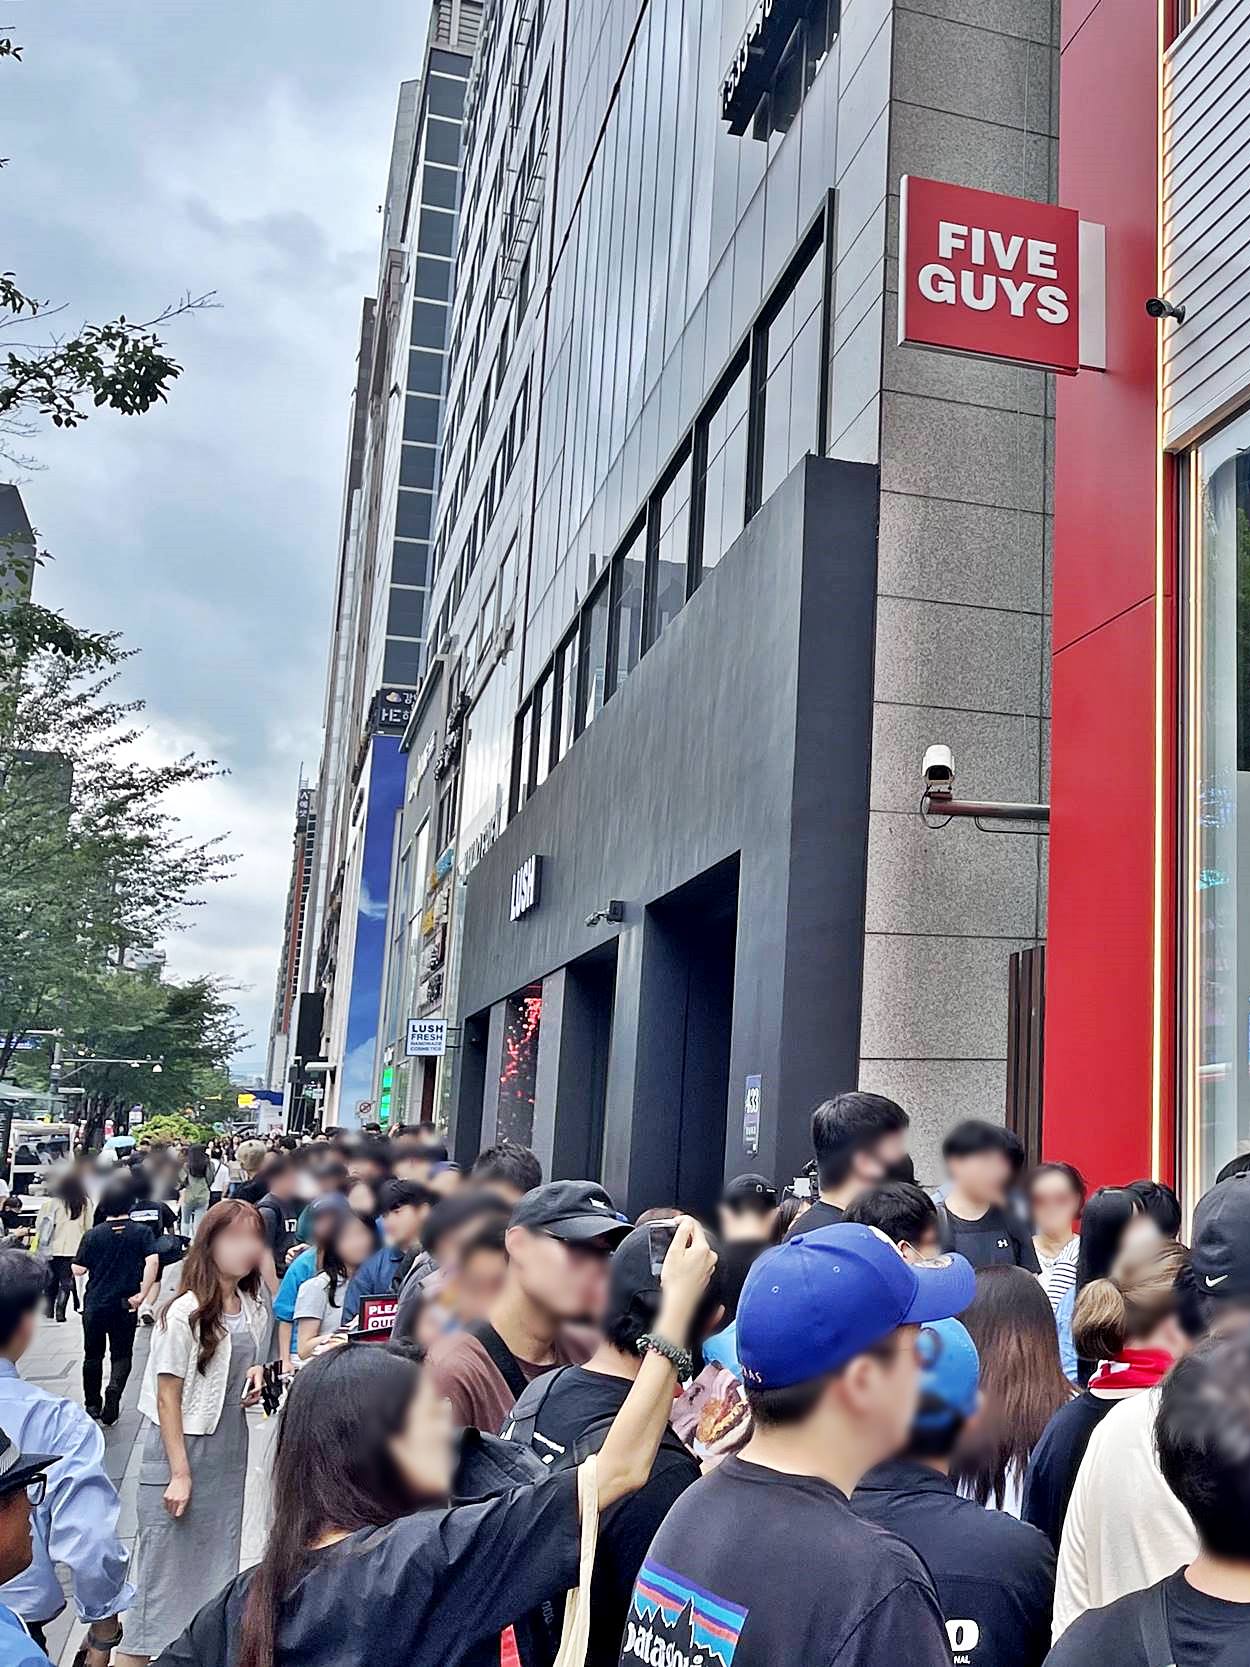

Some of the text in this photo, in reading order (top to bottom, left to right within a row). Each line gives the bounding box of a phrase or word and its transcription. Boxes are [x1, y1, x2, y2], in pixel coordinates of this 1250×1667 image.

[938, 220, 1058, 280] FIVE
[918, 263, 1070, 325] GUYS
[510, 855, 536, 922] LUSH
[411, 1033, 443, 1041] FRESH
[412, 1024, 444, 1033] LUSH
[368, 1303, 399, 1316] PLEA
